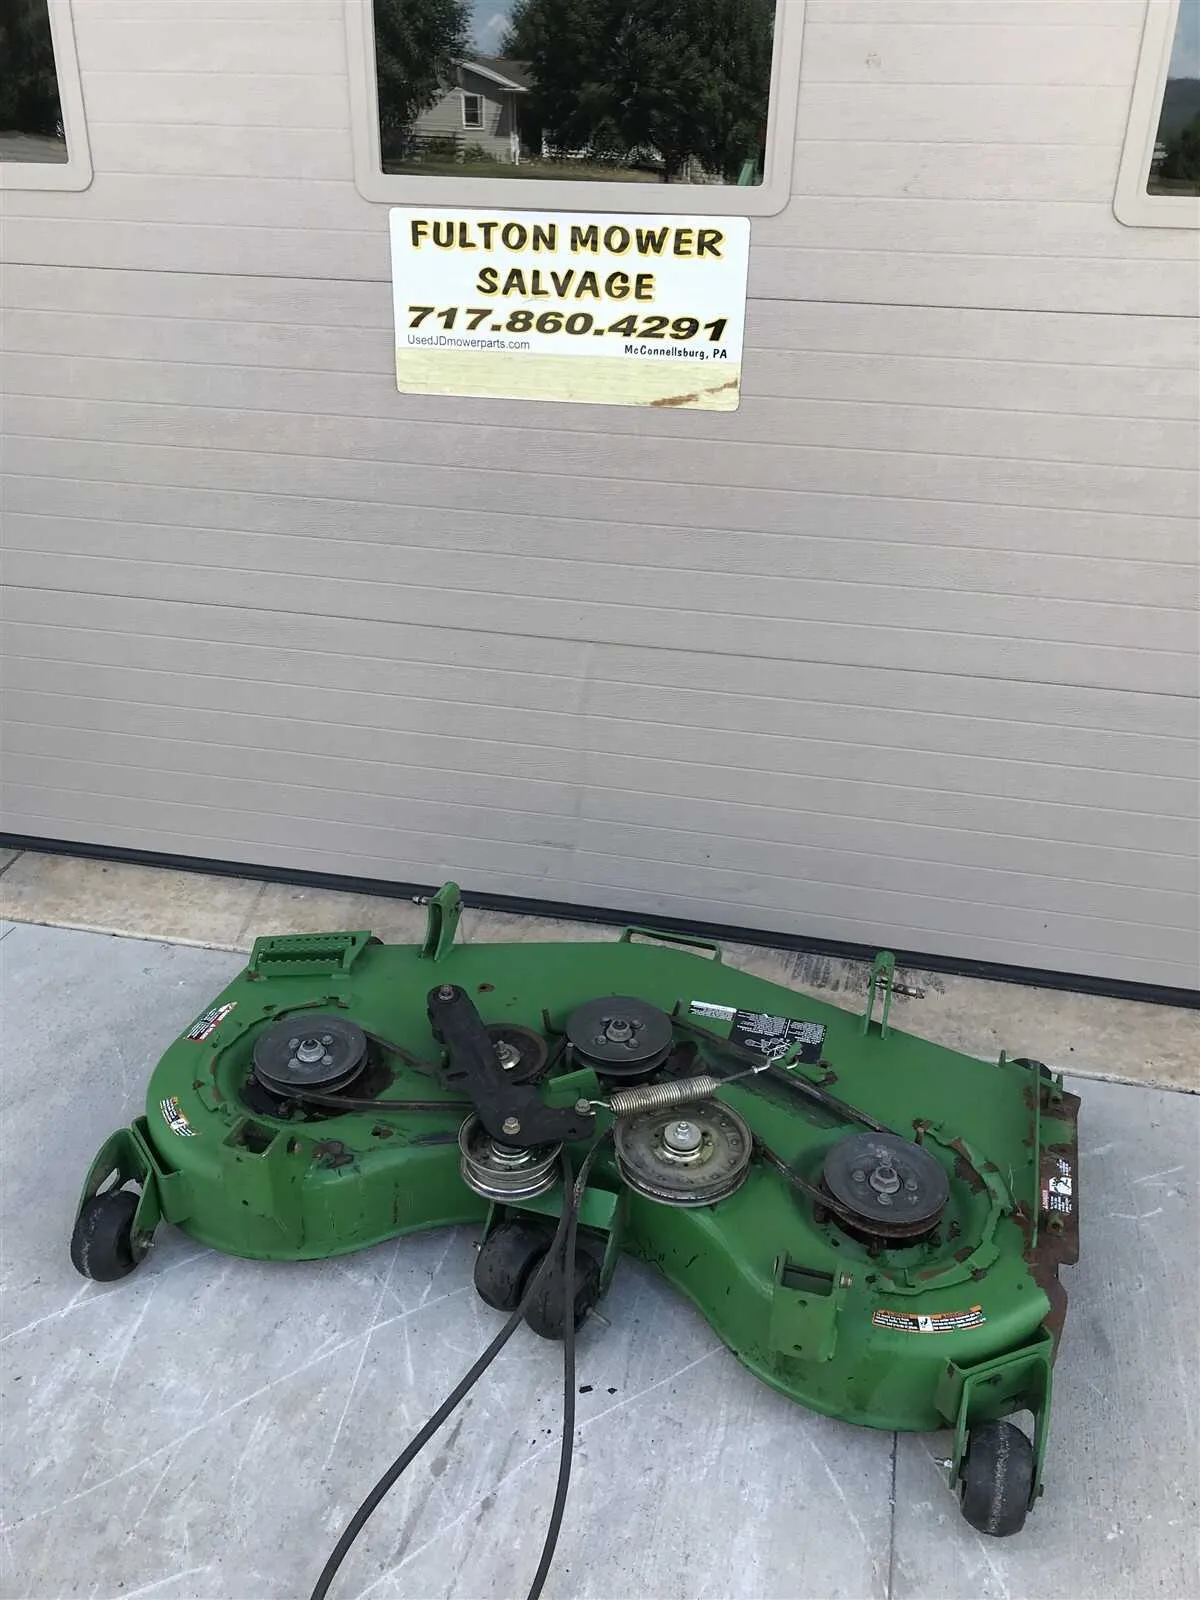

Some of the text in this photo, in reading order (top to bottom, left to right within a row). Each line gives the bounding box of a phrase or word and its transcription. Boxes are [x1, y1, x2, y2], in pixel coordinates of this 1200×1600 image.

[411, 220, 724, 257] FULTON MOWER
[476, 267, 655, 300] SALVAGE
[407, 306, 728, 341] 717.860.4291
[407, 334, 530, 350] UsedJDmowerparts.com
[624, 345, 727, 360] McConnellsburg, PA
